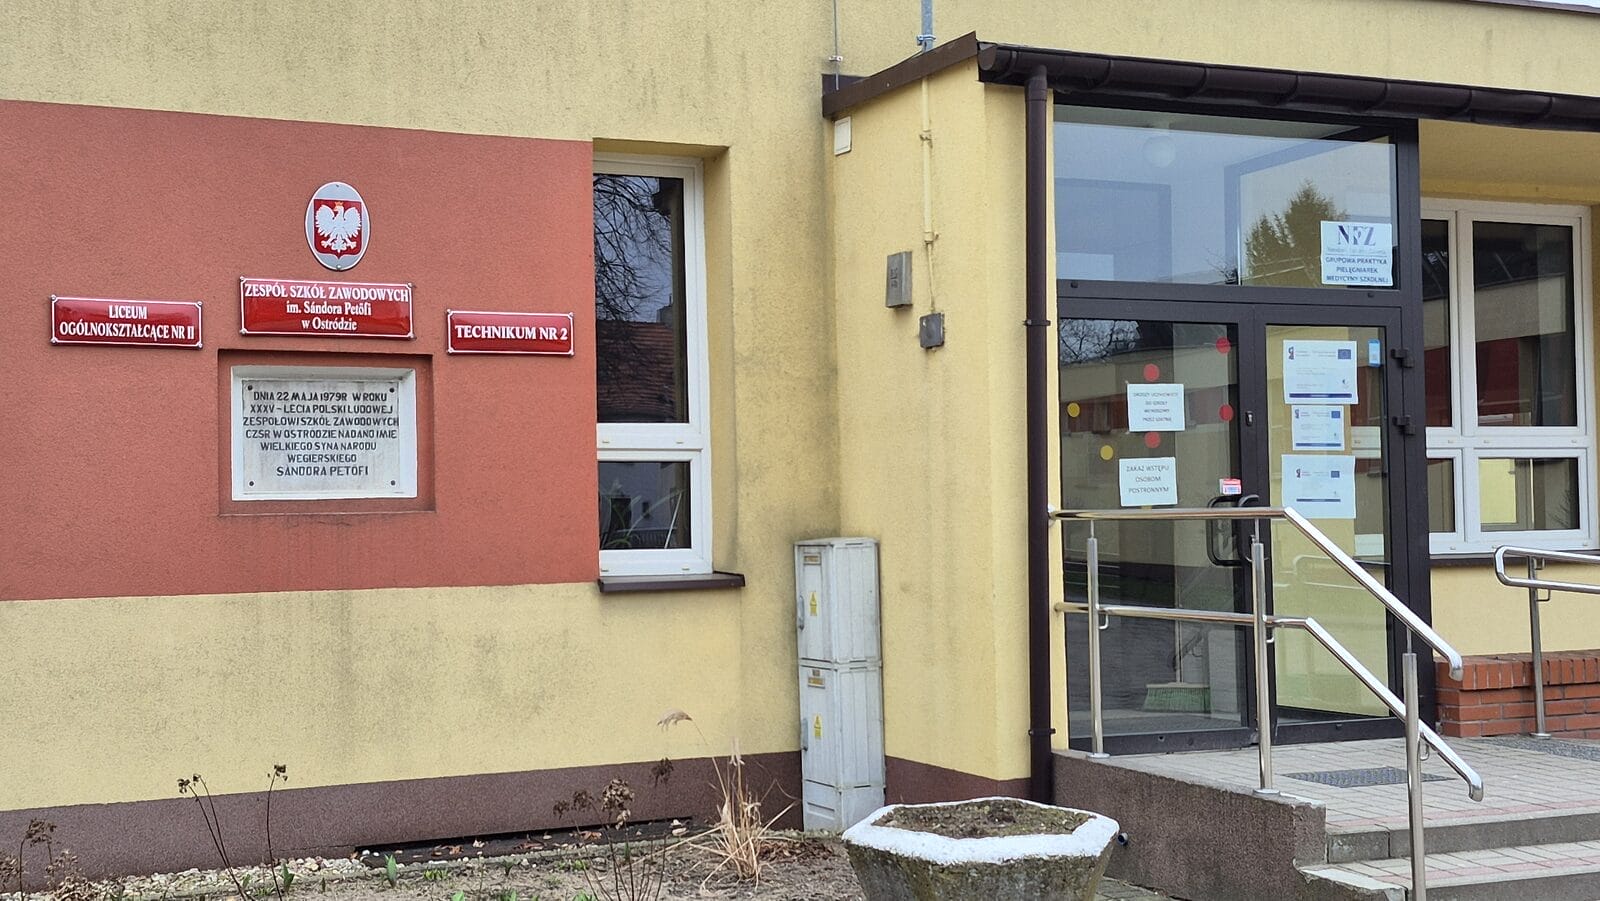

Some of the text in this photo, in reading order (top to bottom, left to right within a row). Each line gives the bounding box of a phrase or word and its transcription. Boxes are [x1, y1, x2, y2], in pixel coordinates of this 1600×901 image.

[1338, 225, 1376, 246] NFZ
[244, 282, 408, 302] ZESPÓŁ SZKÓŁ ZAWODOWYCH
[108, 305, 147, 319] LICEUM
[286, 300, 302, 314] im.
[304, 301, 342, 315] Sándora
[60, 319, 195, 341] OGÓLNOKSZTAŁCĄCE NR II
[301, 317, 357, 330] w Ostródzie
[455, 325, 568, 340] TECHNIKUM NR 2
[254, 391, 275, 400] DNIA
[276, 391, 289, 401] 22
[291, 392, 319, 401] MAJA
[352, 392, 361, 401] W
[362, 392, 387, 401] ROKU
[250, 404, 275, 413] XXXV
[284, 404, 310, 413] LECIA
[312, 404, 346, 413] POLSKI
[348, 405, 393, 414] LUDOWEJ
[333, 417, 399, 426] ZAWODOWYCH
[246, 430, 270, 438] CZSR
[273, 430, 282, 438] W
[338, 430, 374, 438] NADANO
[260, 442, 377, 451] WIELKIEGO SYNA NARODU
